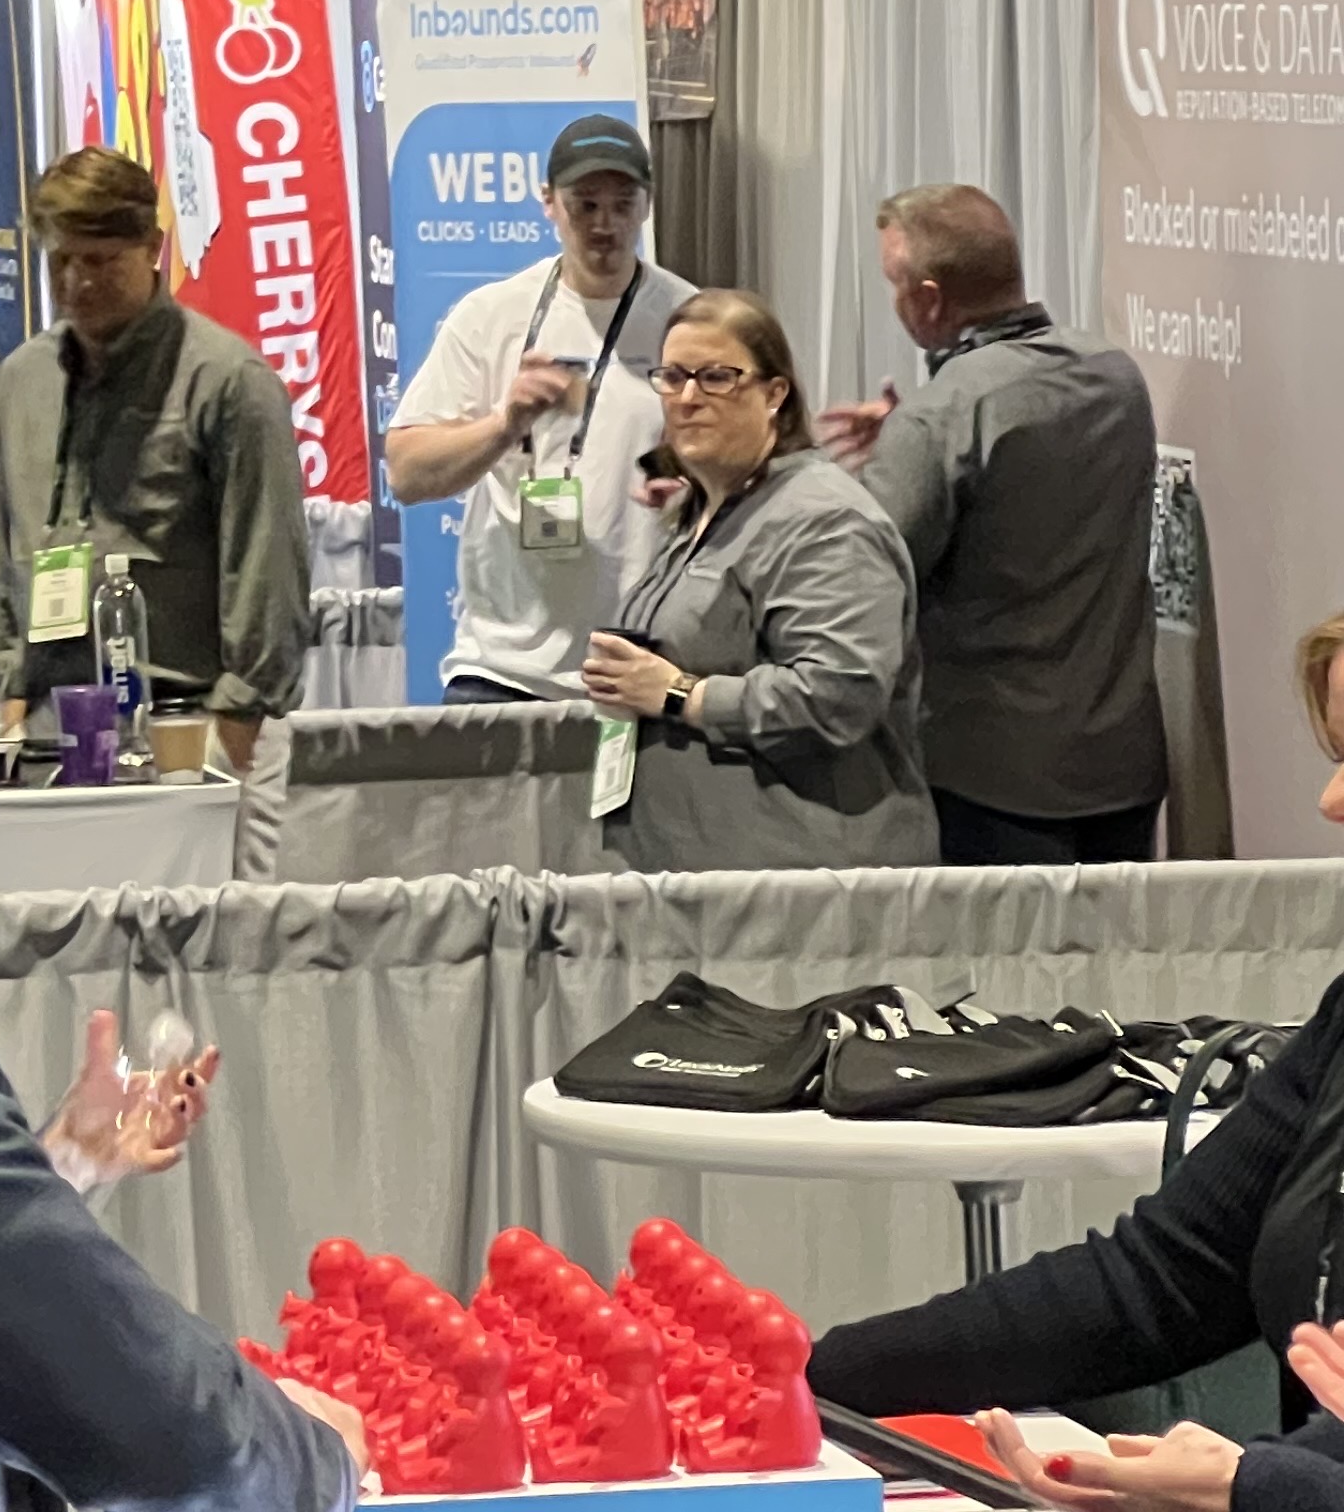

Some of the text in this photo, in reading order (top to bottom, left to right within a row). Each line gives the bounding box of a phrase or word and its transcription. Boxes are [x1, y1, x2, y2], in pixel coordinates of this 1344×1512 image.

[1173, 3, 1344, 75] VOICE & DATA
[428, 151, 546, 203] WE BU
[417, 220, 475, 243] CLICKS
[488, 220, 540, 243] LEADS
[1123, 184, 1196, 249] Blocked
[1199, 206, 1220, 253] or
[1223, 191, 1330, 262] mislabeled
[236, 101, 331, 504] CHERRY
[1126, 292, 1243, 381] We can help!
